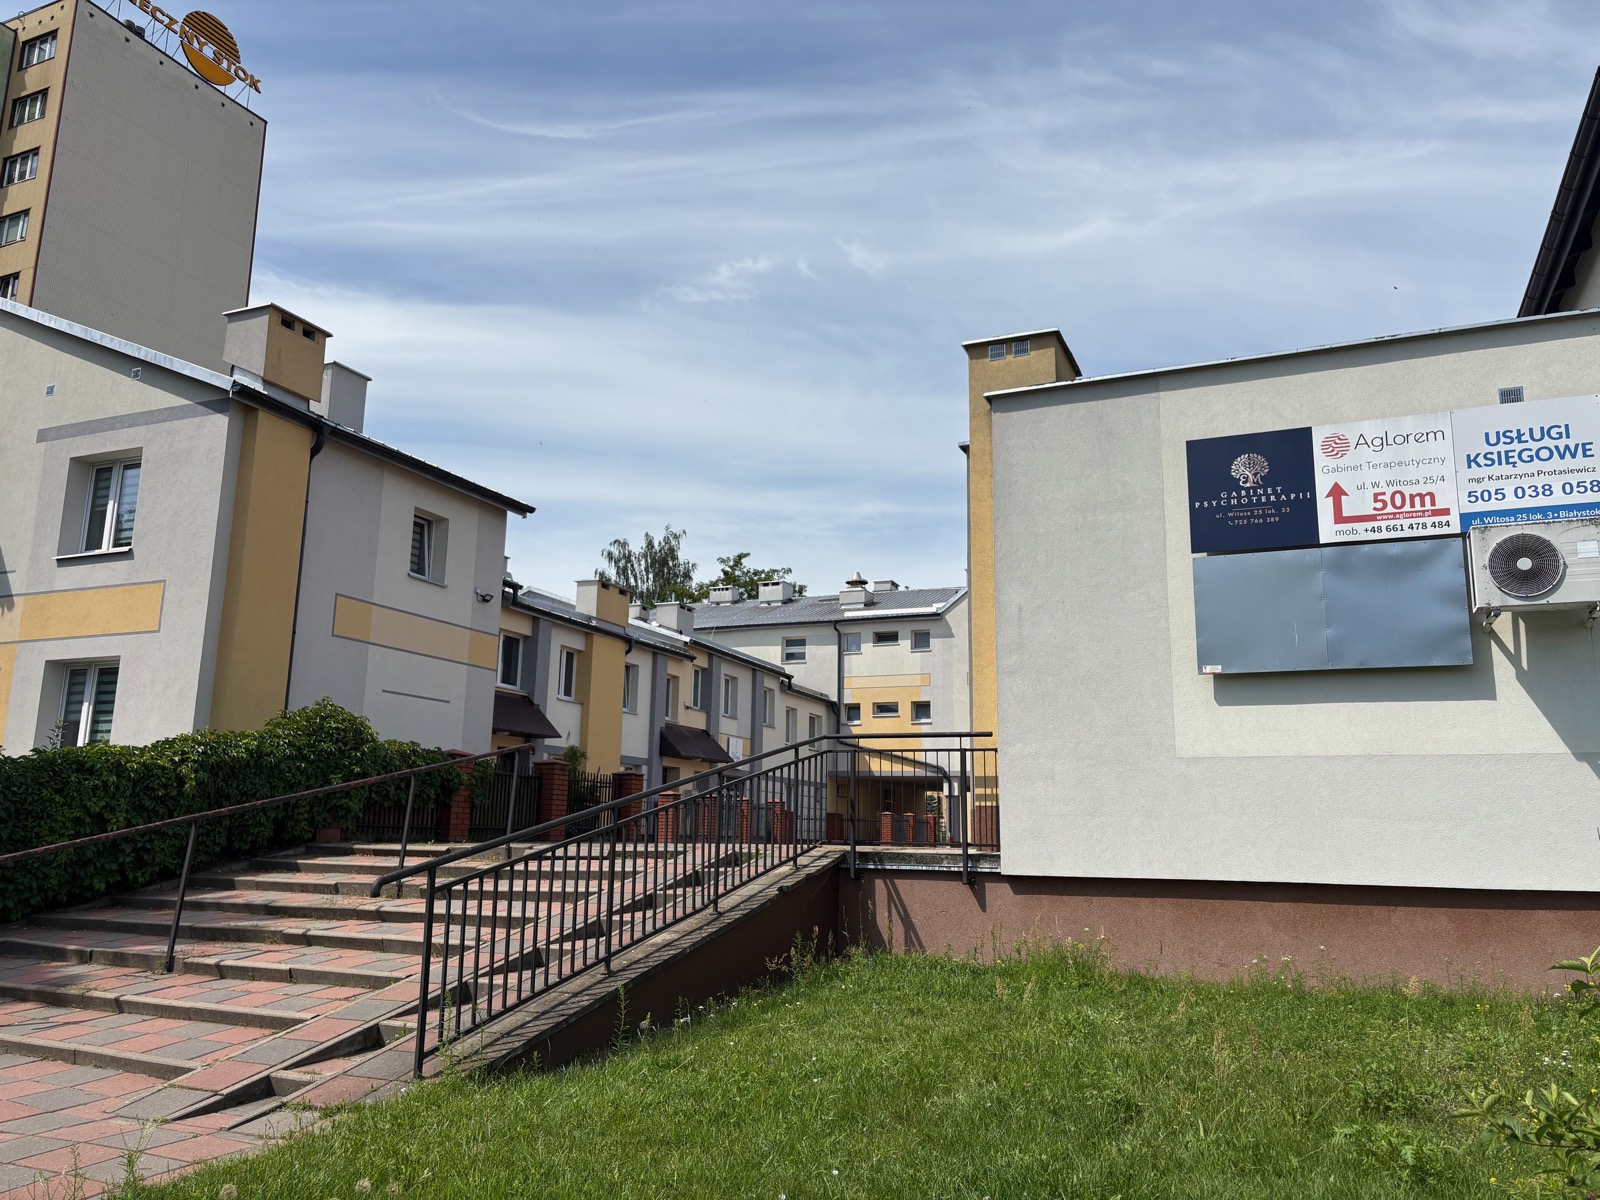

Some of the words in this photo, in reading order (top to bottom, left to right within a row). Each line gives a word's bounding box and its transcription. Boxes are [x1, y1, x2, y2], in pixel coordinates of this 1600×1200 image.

[128, 0, 208, 52] ECZNY
[213, 49, 261, 94] STOK
[1354, 429, 1445, 453] AgLorem
[1484, 423, 1571, 447] USŁUGI
[1465, 441, 1595, 469] KSIĘGOWE
[1321, 463, 1363, 475] Gabinet
[1365, 456, 1446, 471] Terapeutyczny
[1468, 476, 1486, 484] mgr
[1488, 470, 1535, 482] Katarzyna
[1537, 465, 1597, 478] Protasiewicz
[1356, 482, 1368, 491] ul.
[1371, 481, 1383, 489] W.
[1385, 478, 1420, 488] Witosa
[1422, 475, 1445, 486] 25/4
[1467, 487, 1506, 504] 505
[1513, 483, 1554, 500] 038
[1561, 479, 1600, 496] 058
[1195, 492, 1311, 509] PSYCHOTERAPII
[1220, 487, 1282, 499] GABINET
[1372, 489, 1437, 512] 50m
[1215, 511, 1225, 519] ul.
[1228, 510, 1251, 518] Witosa
[1376, 510, 1432, 521] www.aglorem.pl
[1471, 517, 1483, 525] ul.
[1483, 514, 1515, 524] Witosa
[1516, 513, 1527, 521] 25
[1529, 511, 1546, 521] lok.
[1546, 511, 1553, 519] 3
[1559, 507, 1600, 519] Białystok
[1335, 526, 1361, 537] mob.
[1363, 525, 1383, 534] +48
[1385, 523, 1405, 533] 661
[1407, 522, 1428, 531] 478
[1430, 520, 1451, 529] 484
